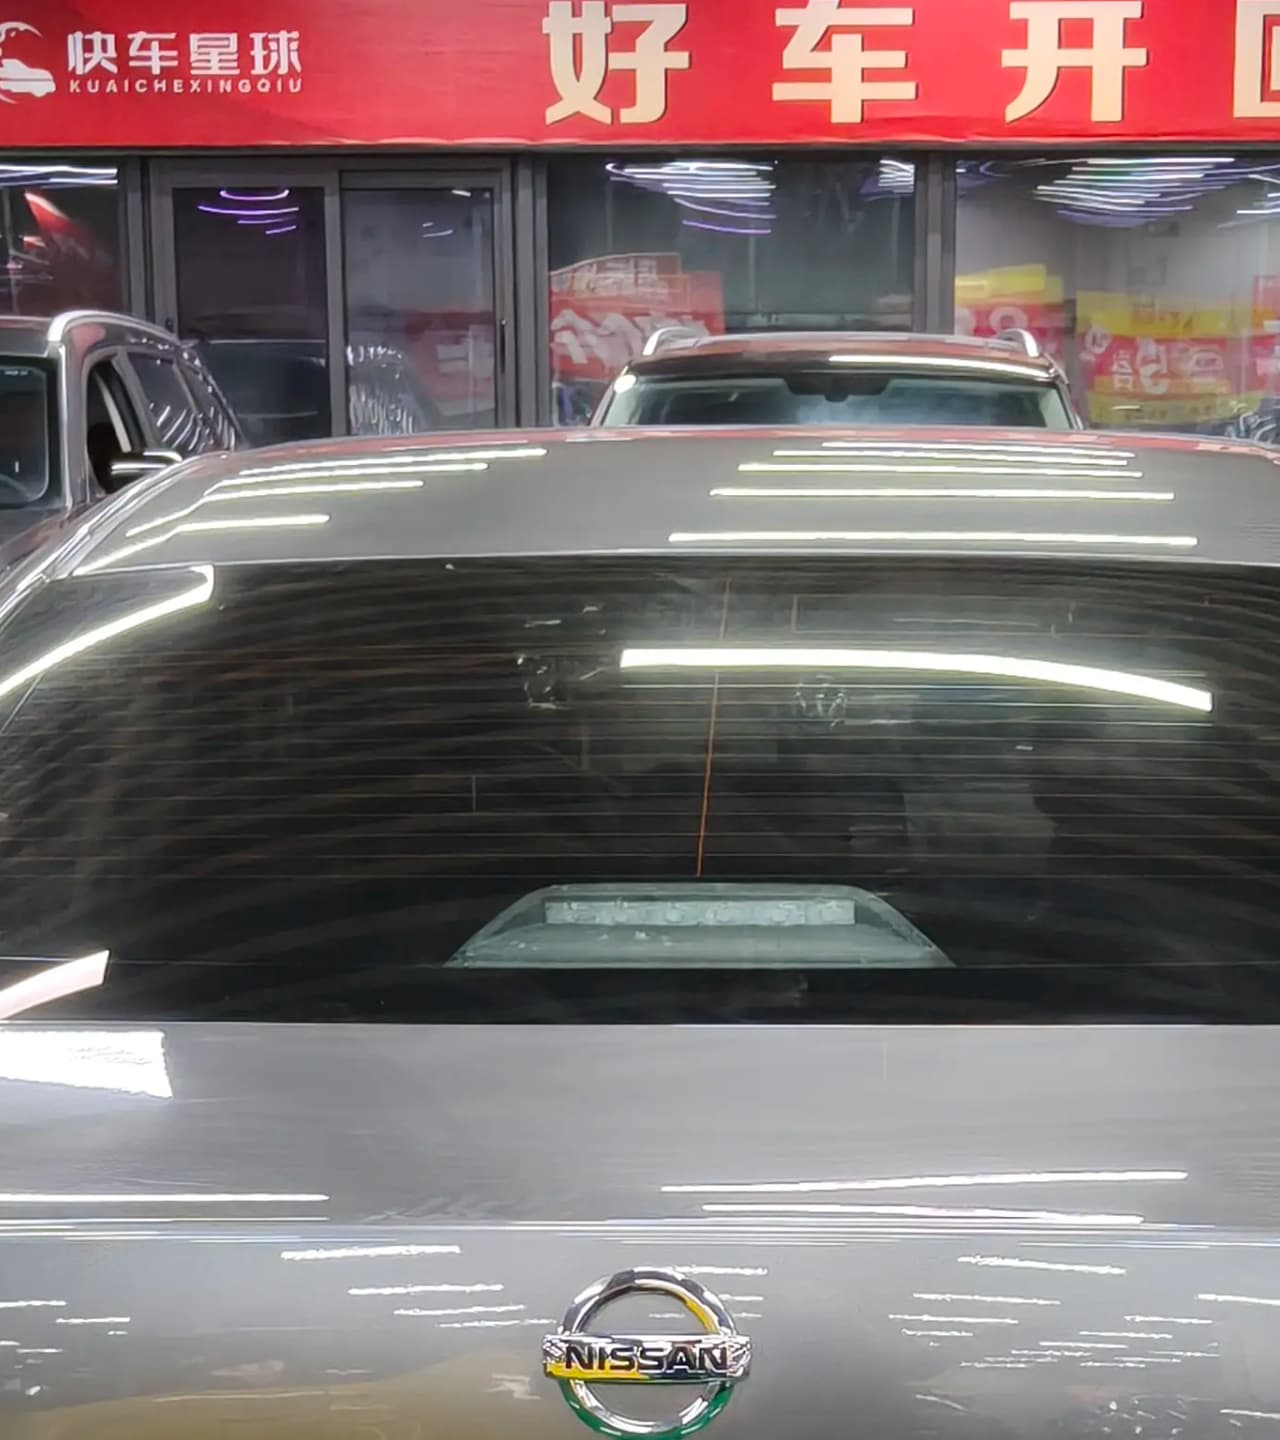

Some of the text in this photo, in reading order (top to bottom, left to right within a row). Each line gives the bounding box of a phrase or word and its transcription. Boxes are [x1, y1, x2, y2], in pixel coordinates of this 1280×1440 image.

[67, 30, 302, 75] 快车星球
[69, 78, 303, 94] KUAICHEXINGQIU
[564, 1343, 730, 1374] NISSAN
